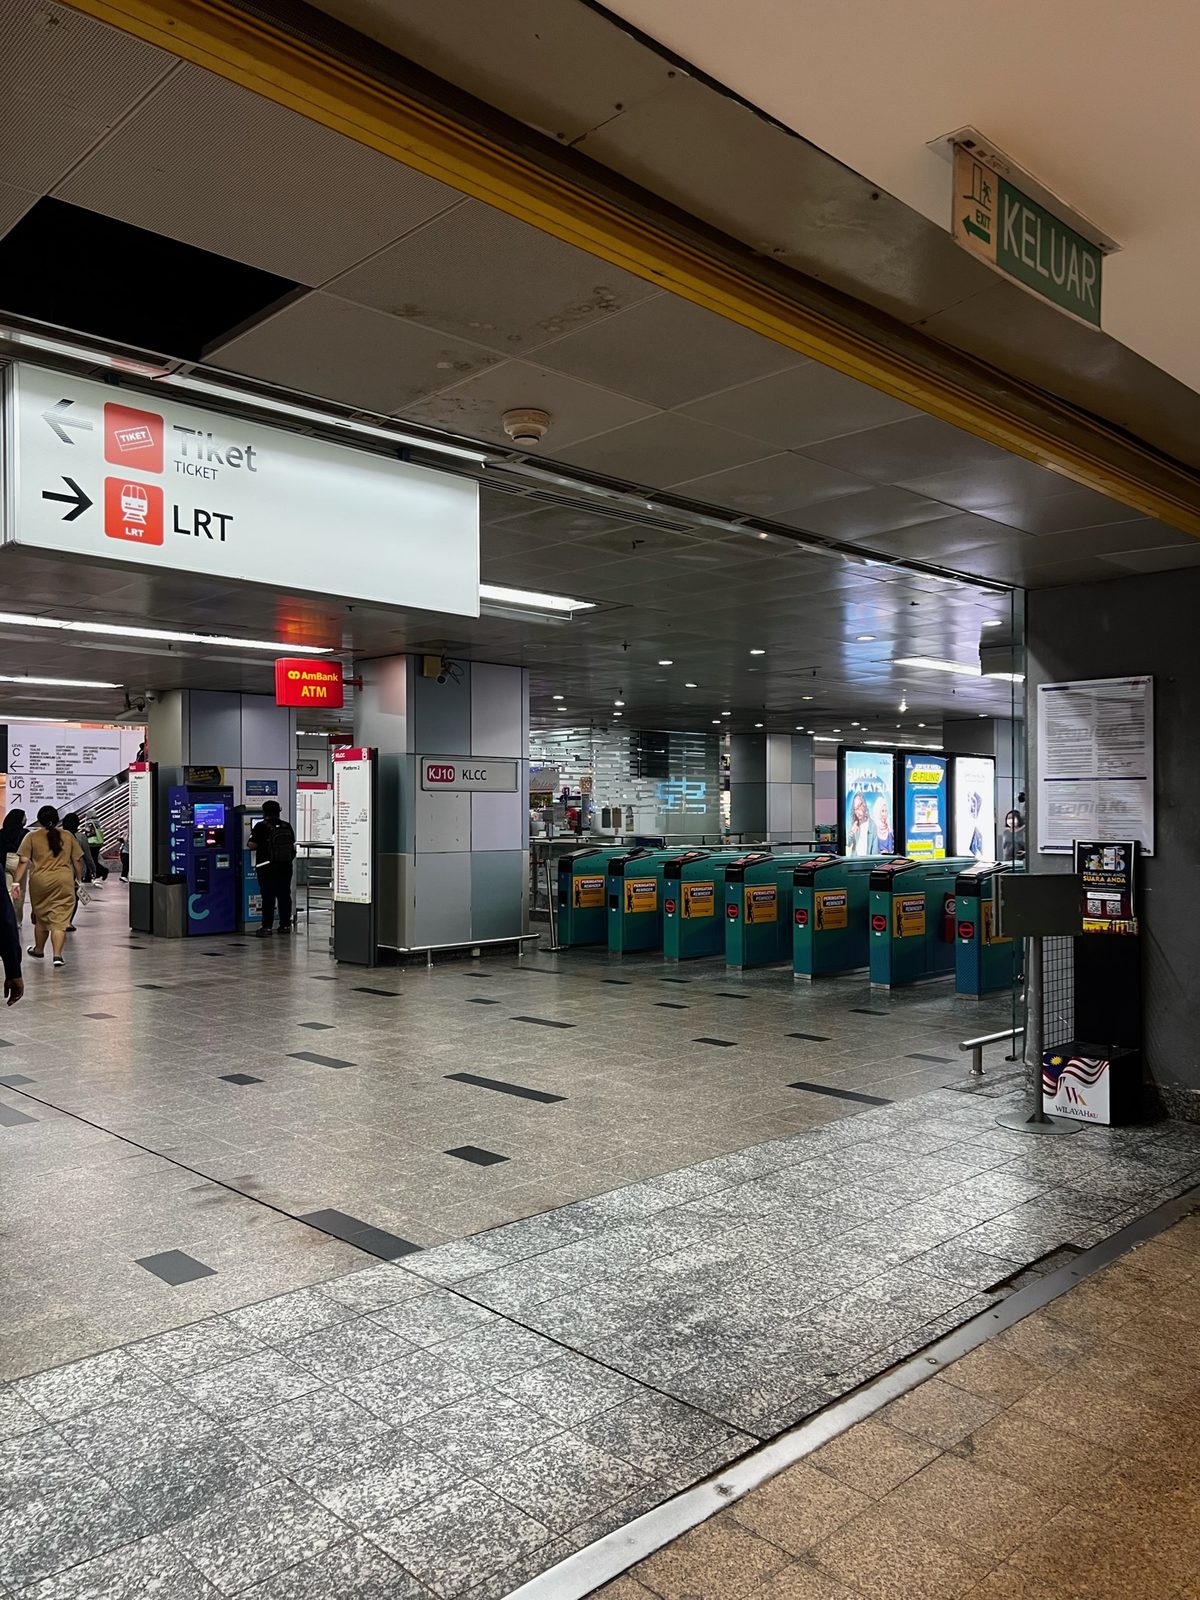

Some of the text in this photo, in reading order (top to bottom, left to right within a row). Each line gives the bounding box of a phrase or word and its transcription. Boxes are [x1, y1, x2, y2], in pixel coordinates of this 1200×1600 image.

[975, 209, 991, 231] EXIT
[1003, 194, 1097, 309] KELUAR
[120, 430, 147, 443] TIKET
[173, 424, 257, 473] Tiket
[174, 460, 218, 481] TICKET
[173, 504, 234, 542] LRT
[125, 526, 145, 537] LRT
[301, 671, 339, 682] AmBank
[301, 685, 328, 698] ATM
[13, 748, 21, 757] C
[429, 767, 455, 781] KJ10
[462, 769, 488, 781] KLCC
[9, 780, 25, 789] UC
